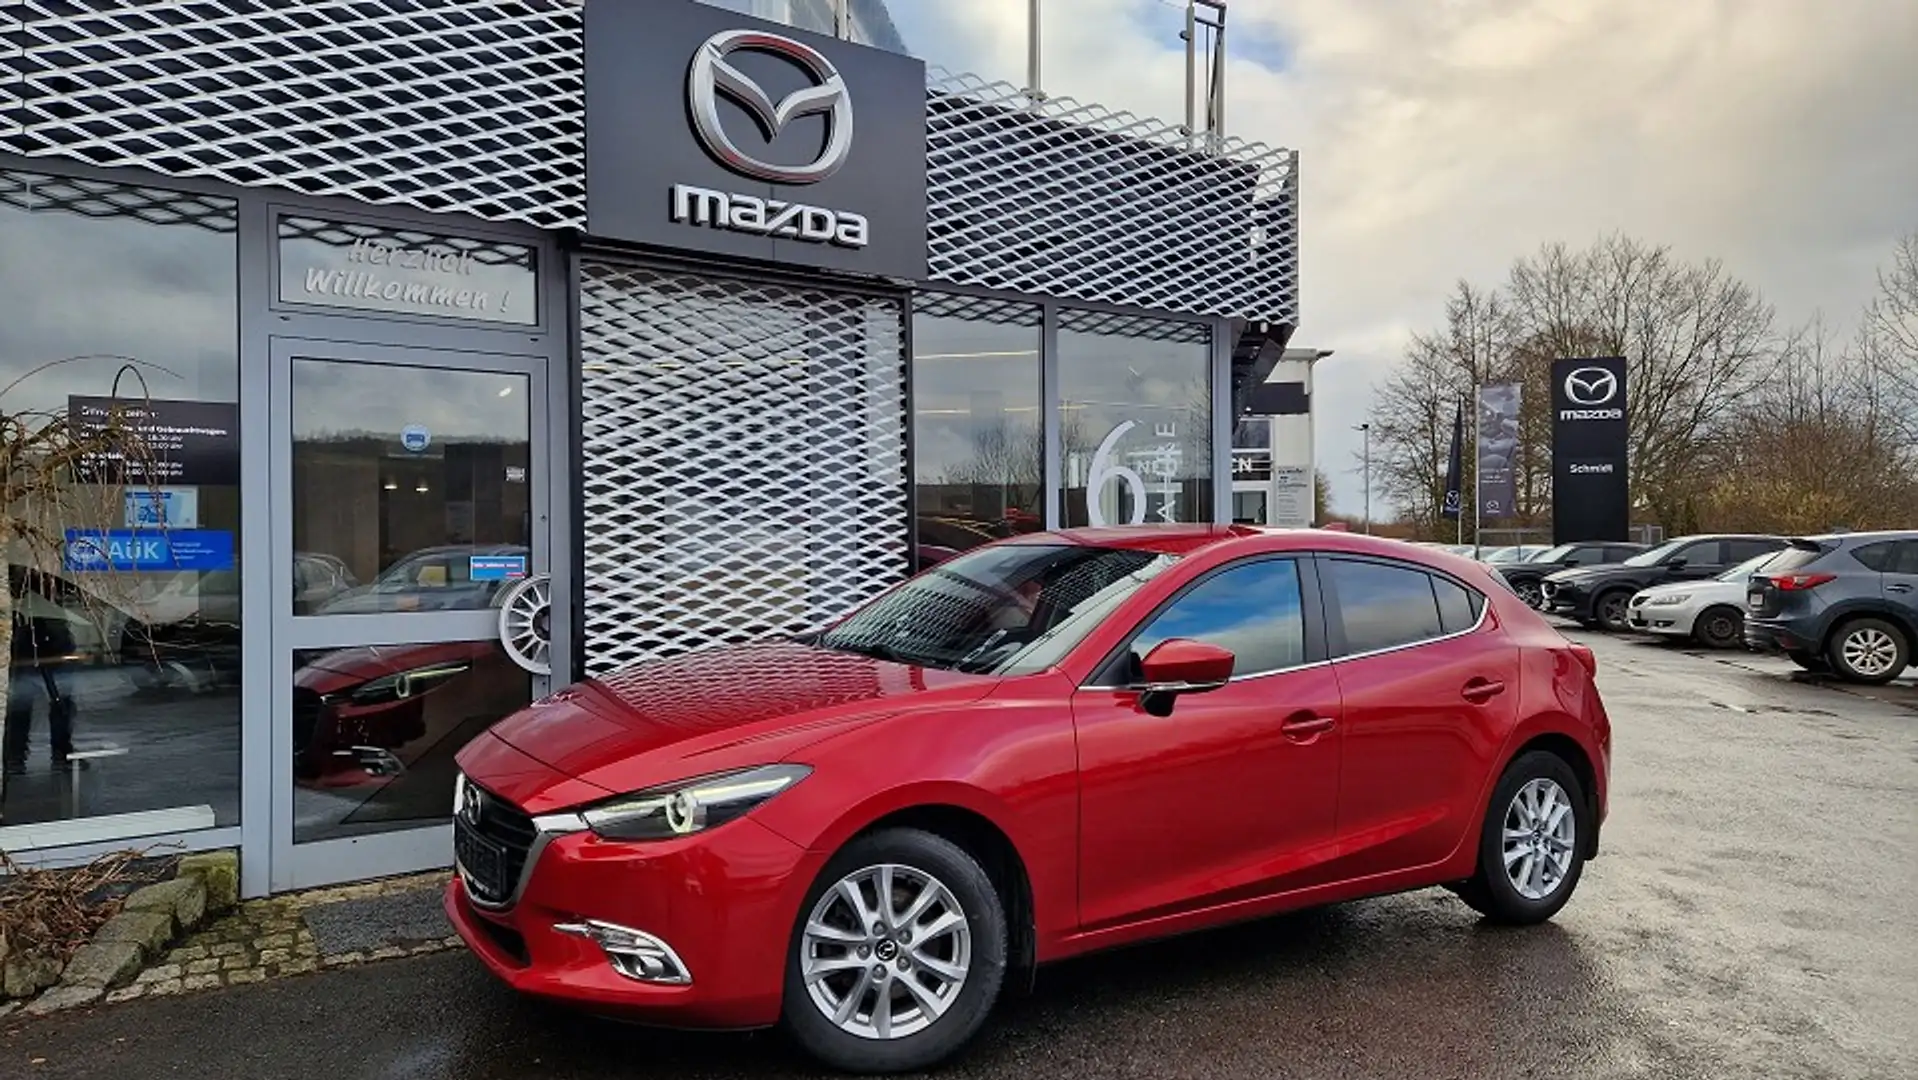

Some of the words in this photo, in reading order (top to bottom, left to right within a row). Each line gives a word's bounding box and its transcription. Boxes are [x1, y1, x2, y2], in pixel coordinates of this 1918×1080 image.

[672, 182, 868, 248] mazda
[347, 237, 474, 276] Herzlich
[304, 267, 489, 311] Willkommen
[1560, 408, 1623, 420] mazda
